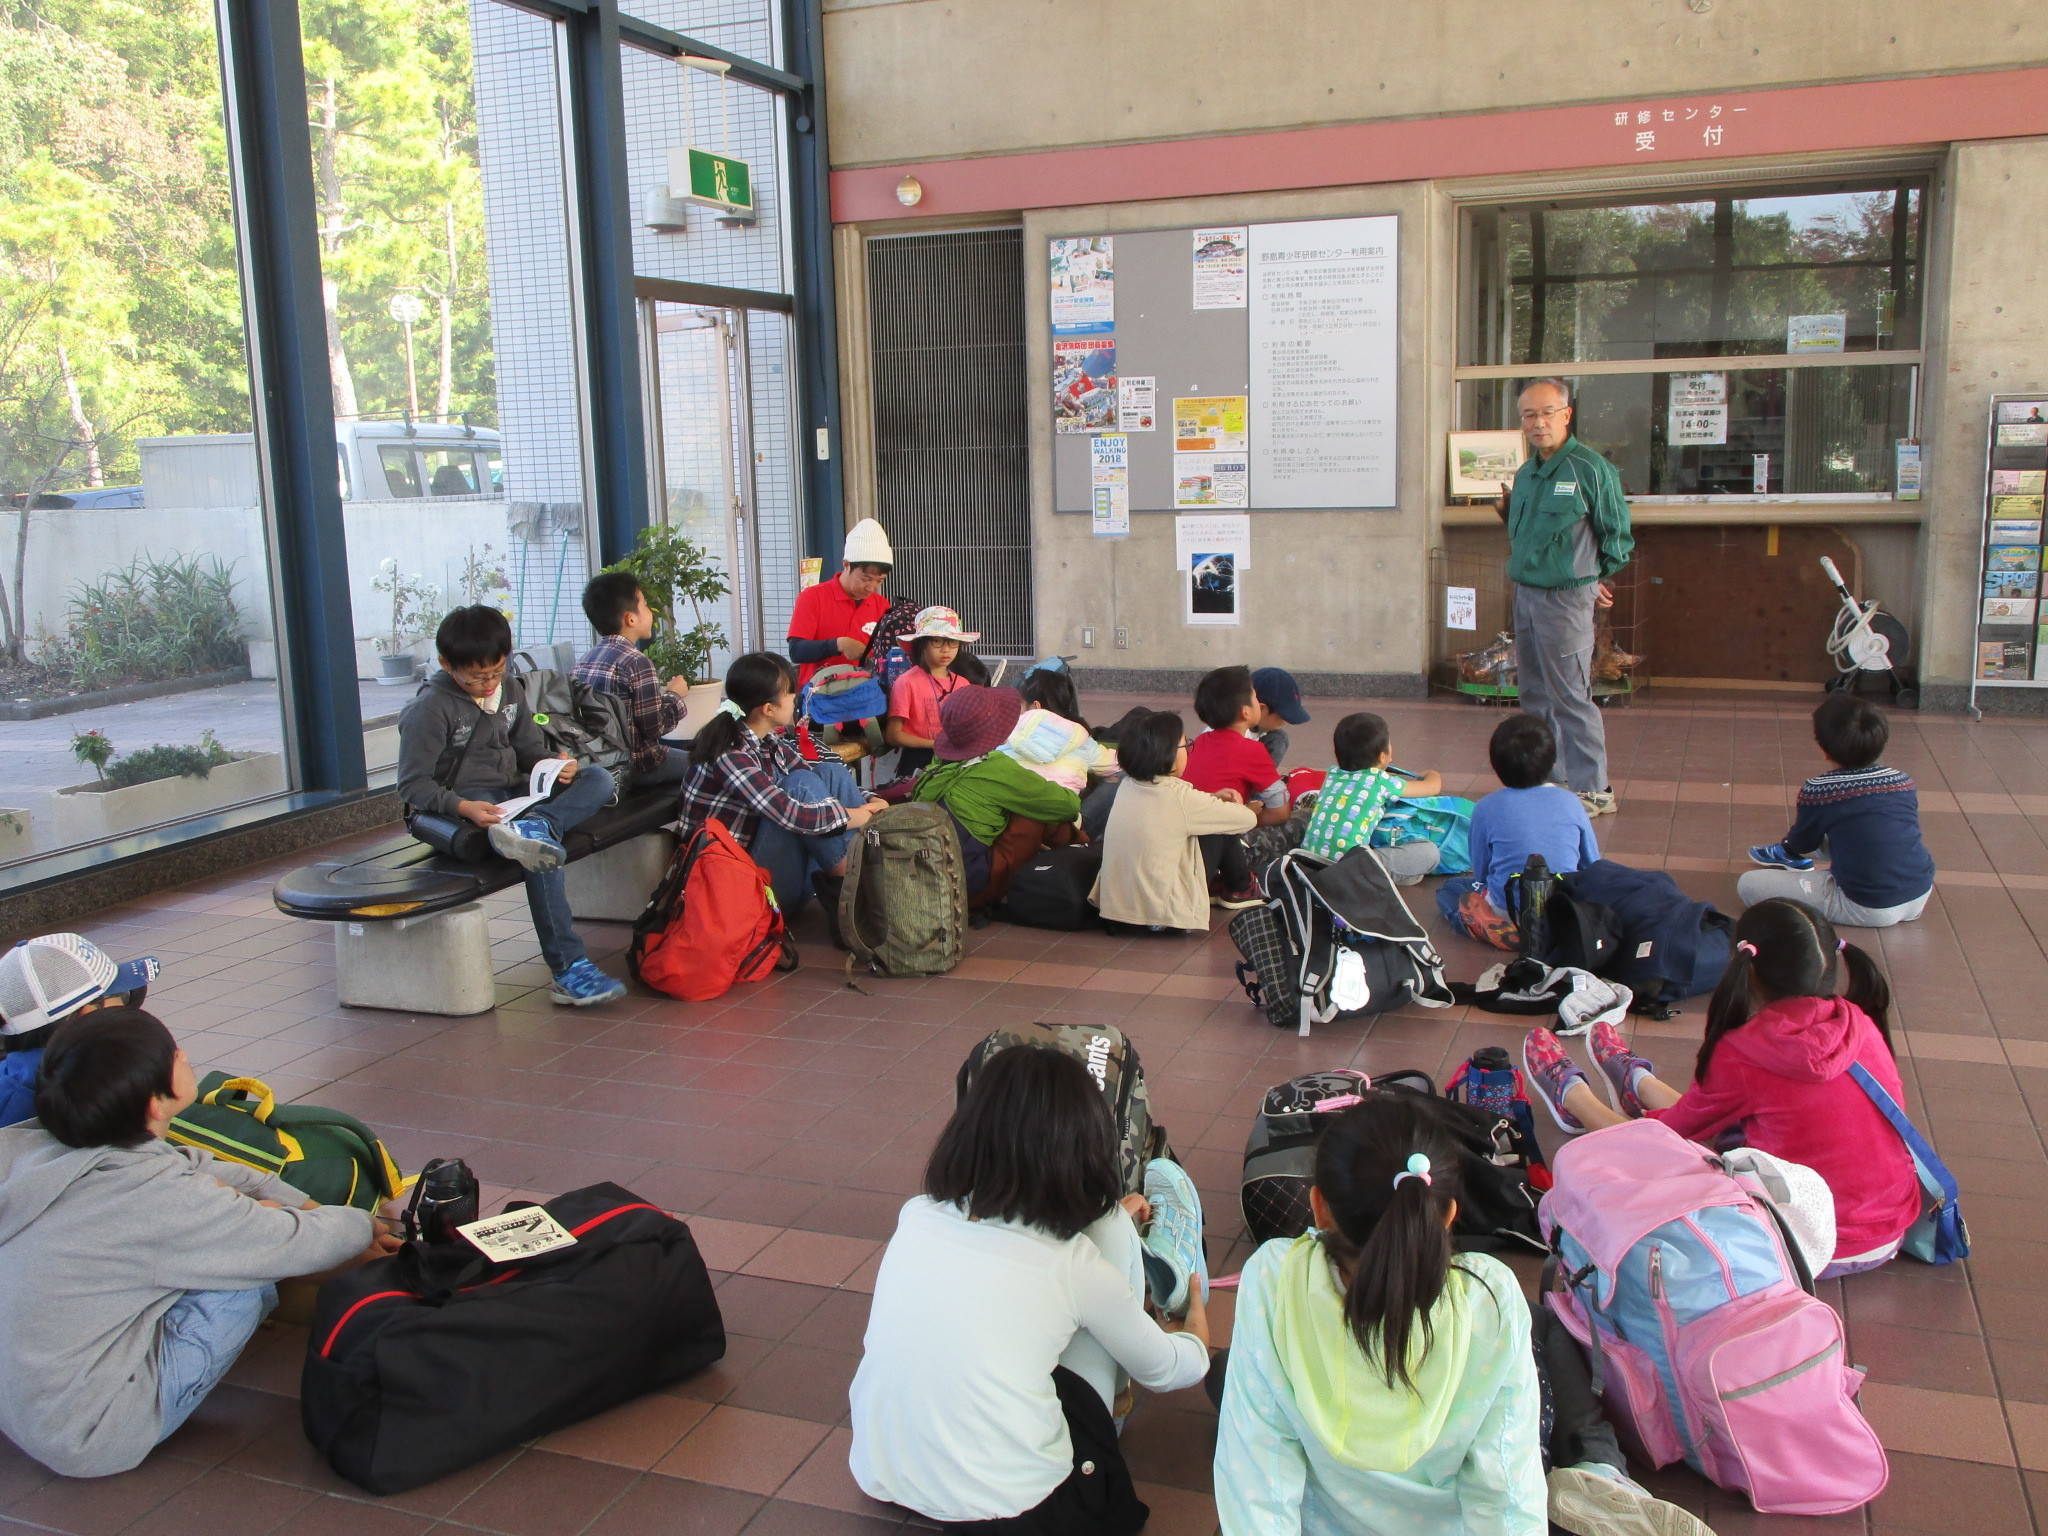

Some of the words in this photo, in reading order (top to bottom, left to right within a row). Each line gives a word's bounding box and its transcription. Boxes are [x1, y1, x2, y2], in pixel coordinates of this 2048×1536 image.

[1614, 104, 1747, 126] 研修センター
[1635, 125, 1724, 152] 受付
[1261, 246, 1385, 261] 野島青少年研修センター利用案内
[1093, 438, 1126, 448] ENJOY
[1093, 446, 1127, 455] WALKING
[1098, 454, 1122, 464] 2018
[1084, 1035, 1111, 1092] ants
